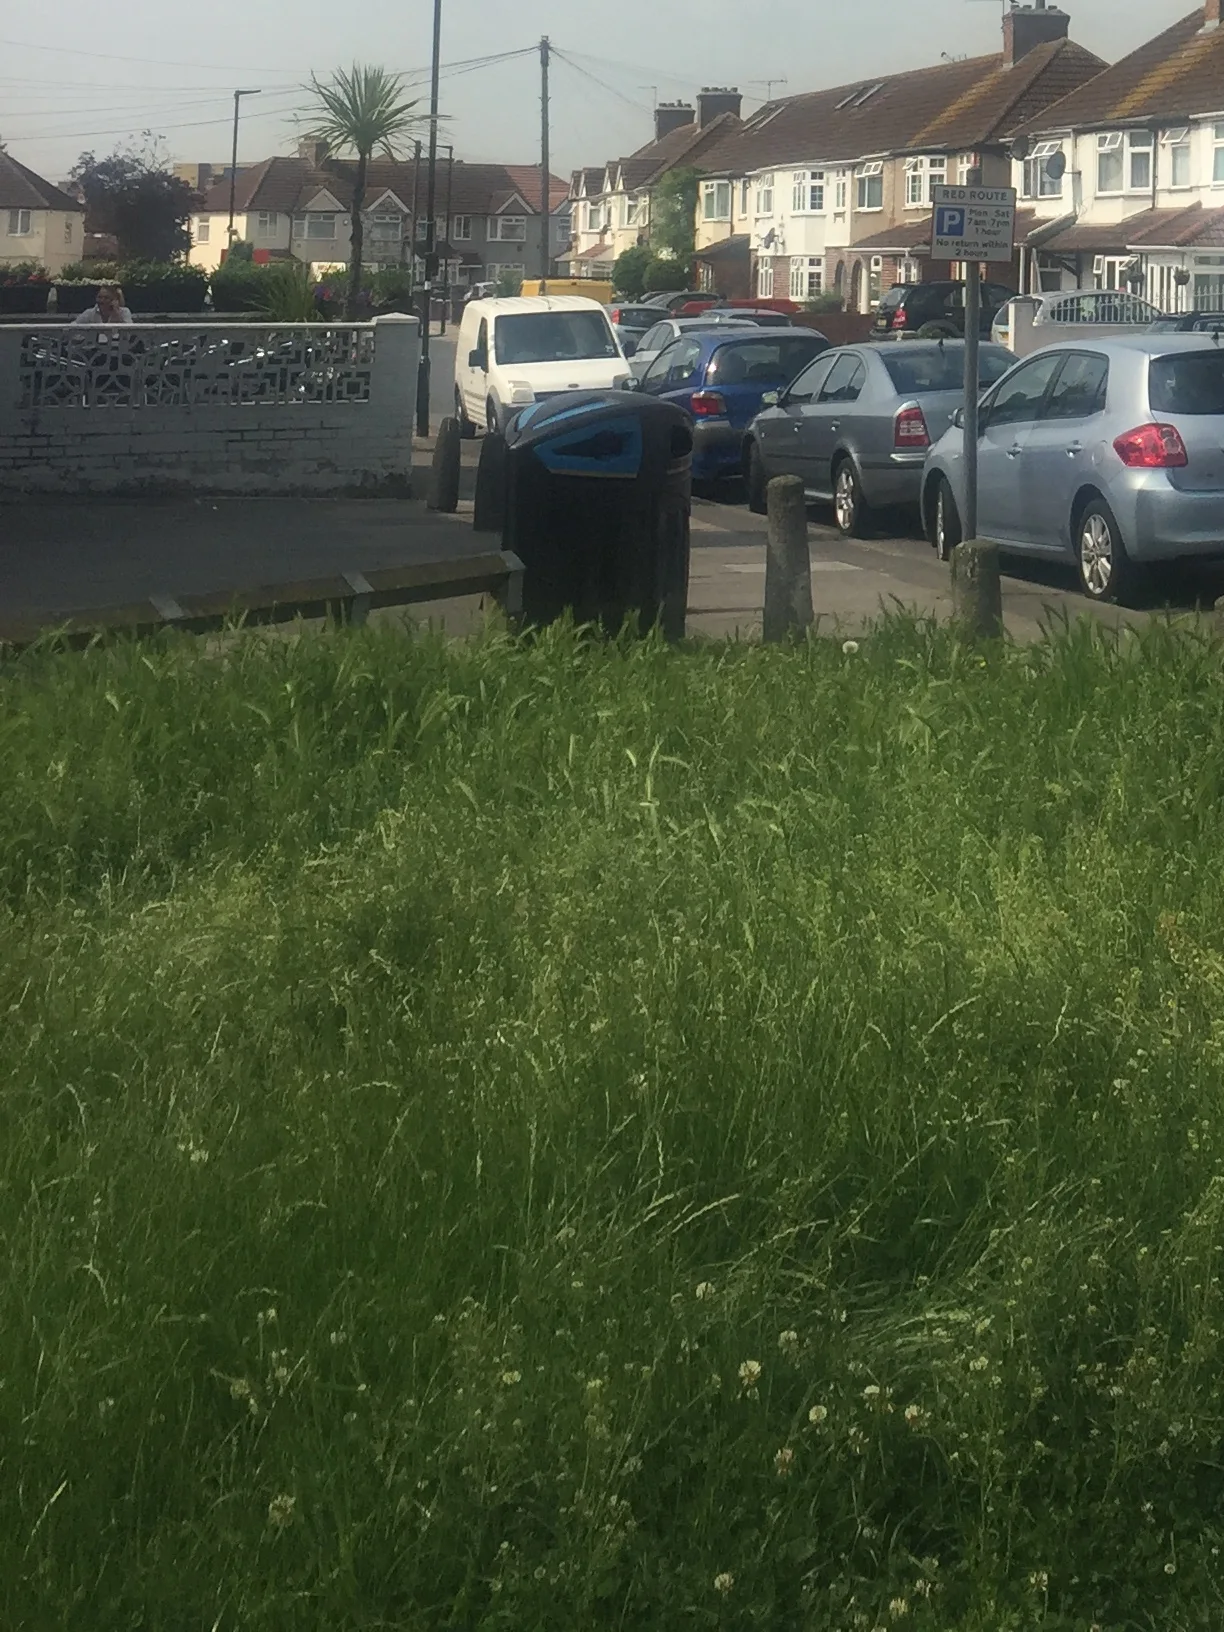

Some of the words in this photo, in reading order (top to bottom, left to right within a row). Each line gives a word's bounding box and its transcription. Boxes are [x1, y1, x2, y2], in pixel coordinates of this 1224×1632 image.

[942, 189, 966, 199] RED
[969, 191, 1008, 201] ROUTE
[994, 209, 1010, 218] Sat
[942, 210, 961, 234] P
[936, 238, 950, 247] No
[951, 240, 979, 248] return
[955, 248, 962, 257] 2
[963, 249, 988, 258] hours
